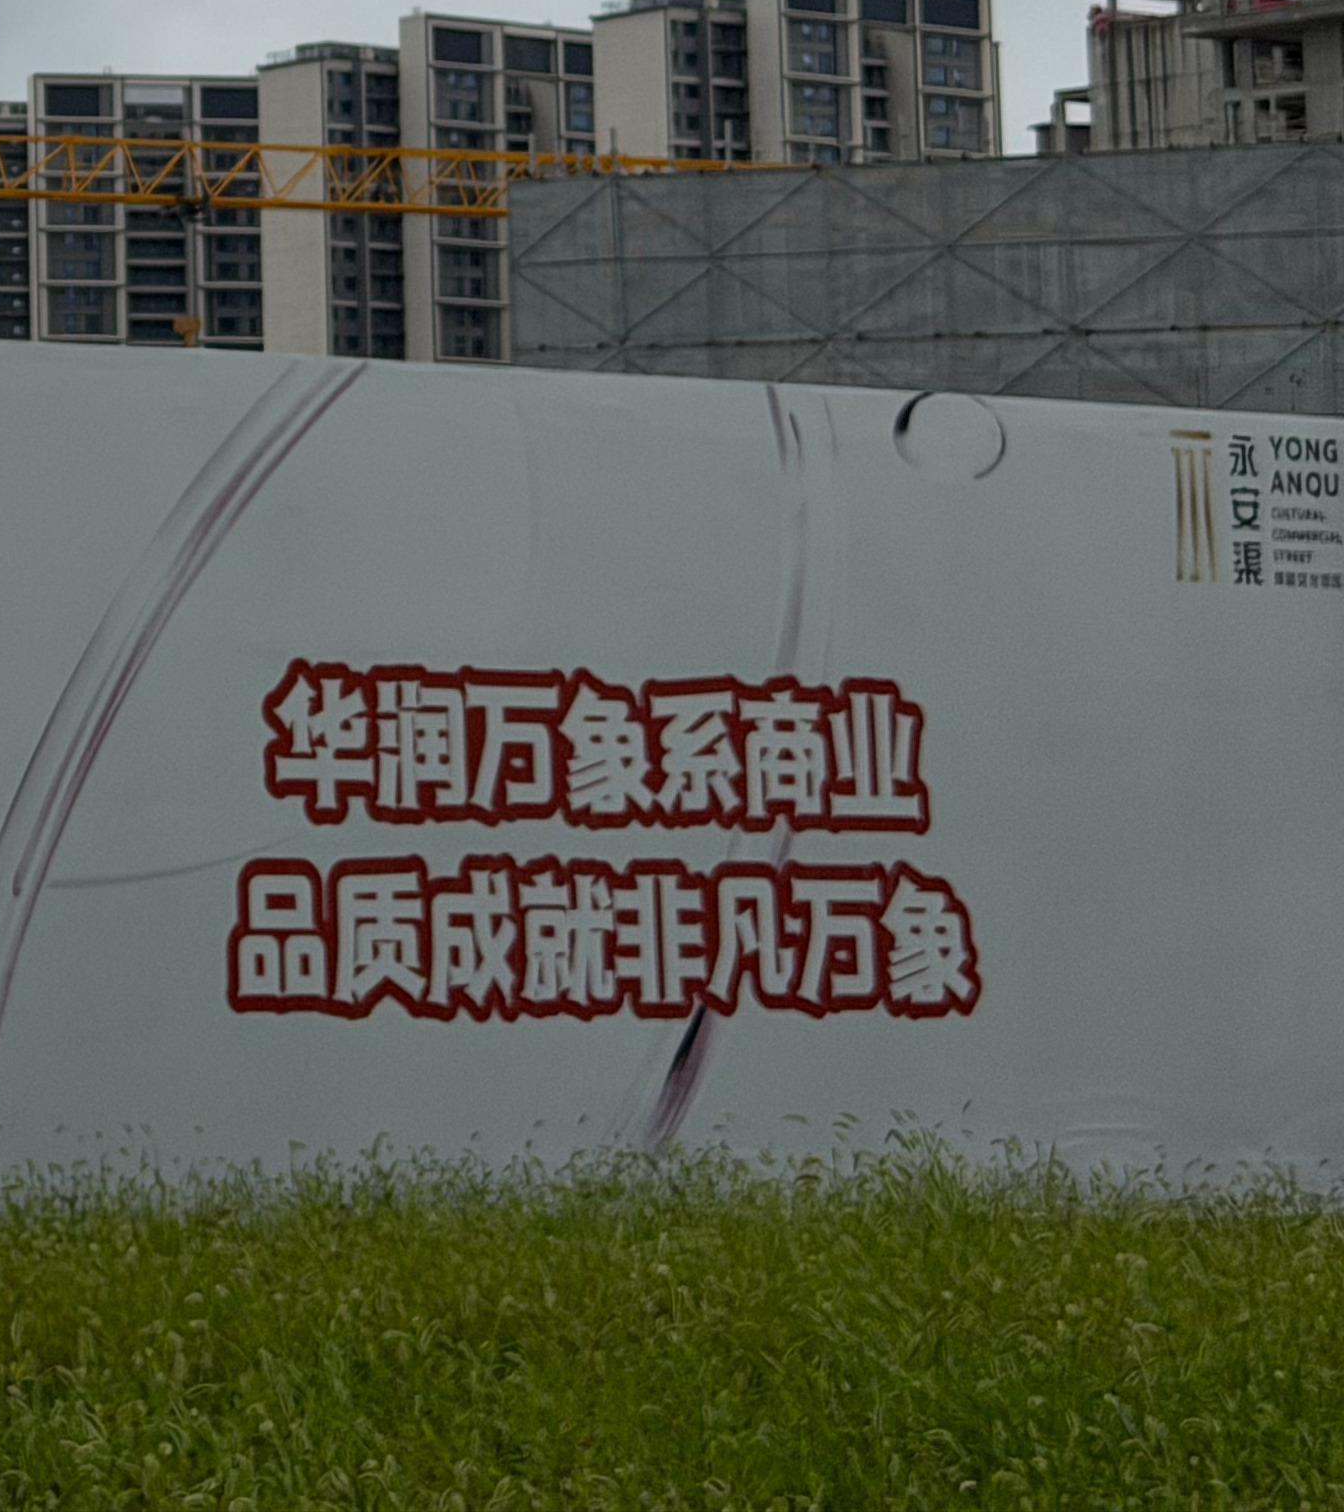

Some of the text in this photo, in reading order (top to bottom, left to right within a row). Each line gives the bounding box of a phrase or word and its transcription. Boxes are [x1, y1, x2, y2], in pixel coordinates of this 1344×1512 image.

[1269, 437, 1338, 463] YONG
[1270, 471, 1339, 498] ANQU
[1271, 506, 1326, 522] CULTURAL
[1273, 549, 1314, 564] STREET
[262, 657, 930, 834] 华润万象系商业
[227, 854, 981, 1021] 品质成就非凡万象
